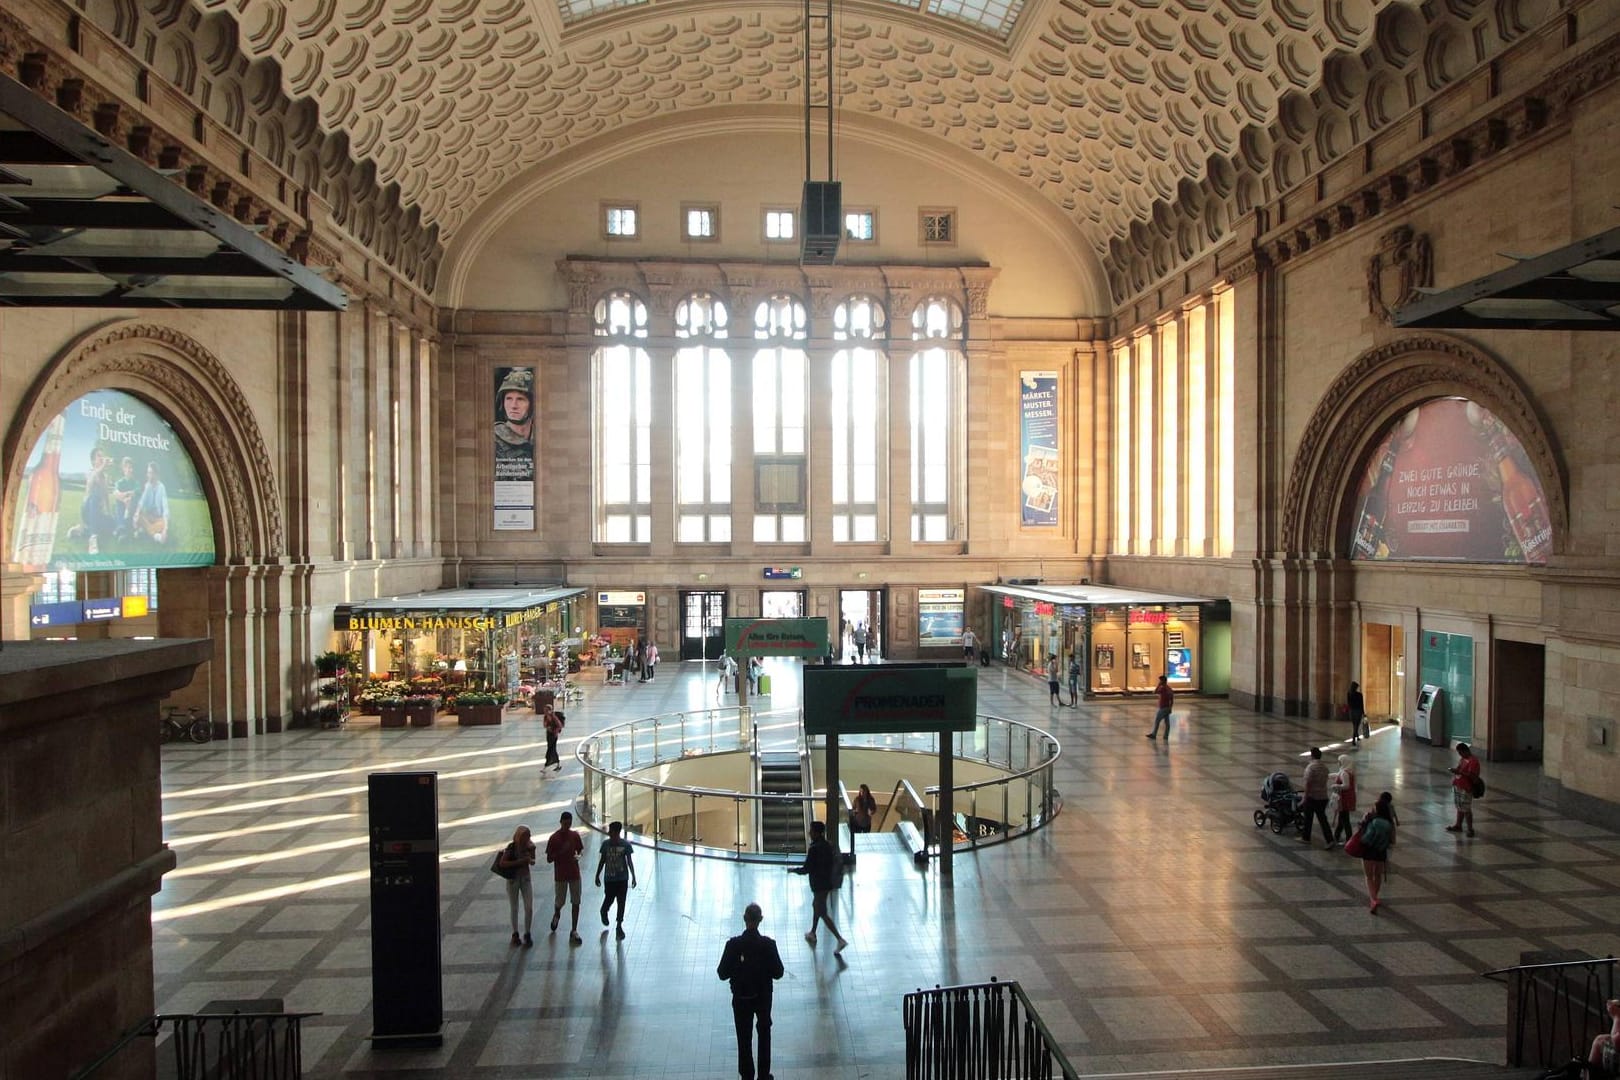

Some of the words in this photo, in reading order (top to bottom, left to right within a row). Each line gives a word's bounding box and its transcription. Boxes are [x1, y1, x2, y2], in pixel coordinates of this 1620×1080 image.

[80, 399, 112, 420] Ende
[116, 407, 136, 427] der
[99, 424, 171, 452] Durststrecke
[1398, 470, 1418, 483] ZWEI
[1420, 467, 1443, 481] GUTE
[1406, 485, 1427, 498] NOCH
[1429, 482, 1457, 496] ETWAS
[1461, 482, 1470, 495] IN
[1397, 501, 1426, 514] LEIPZIG
[1430, 499, 1441, 512] ZU
[349, 616, 496, 631] BLUMEN-HANISCH
[855, 694, 945, 709] PROMENADEN
